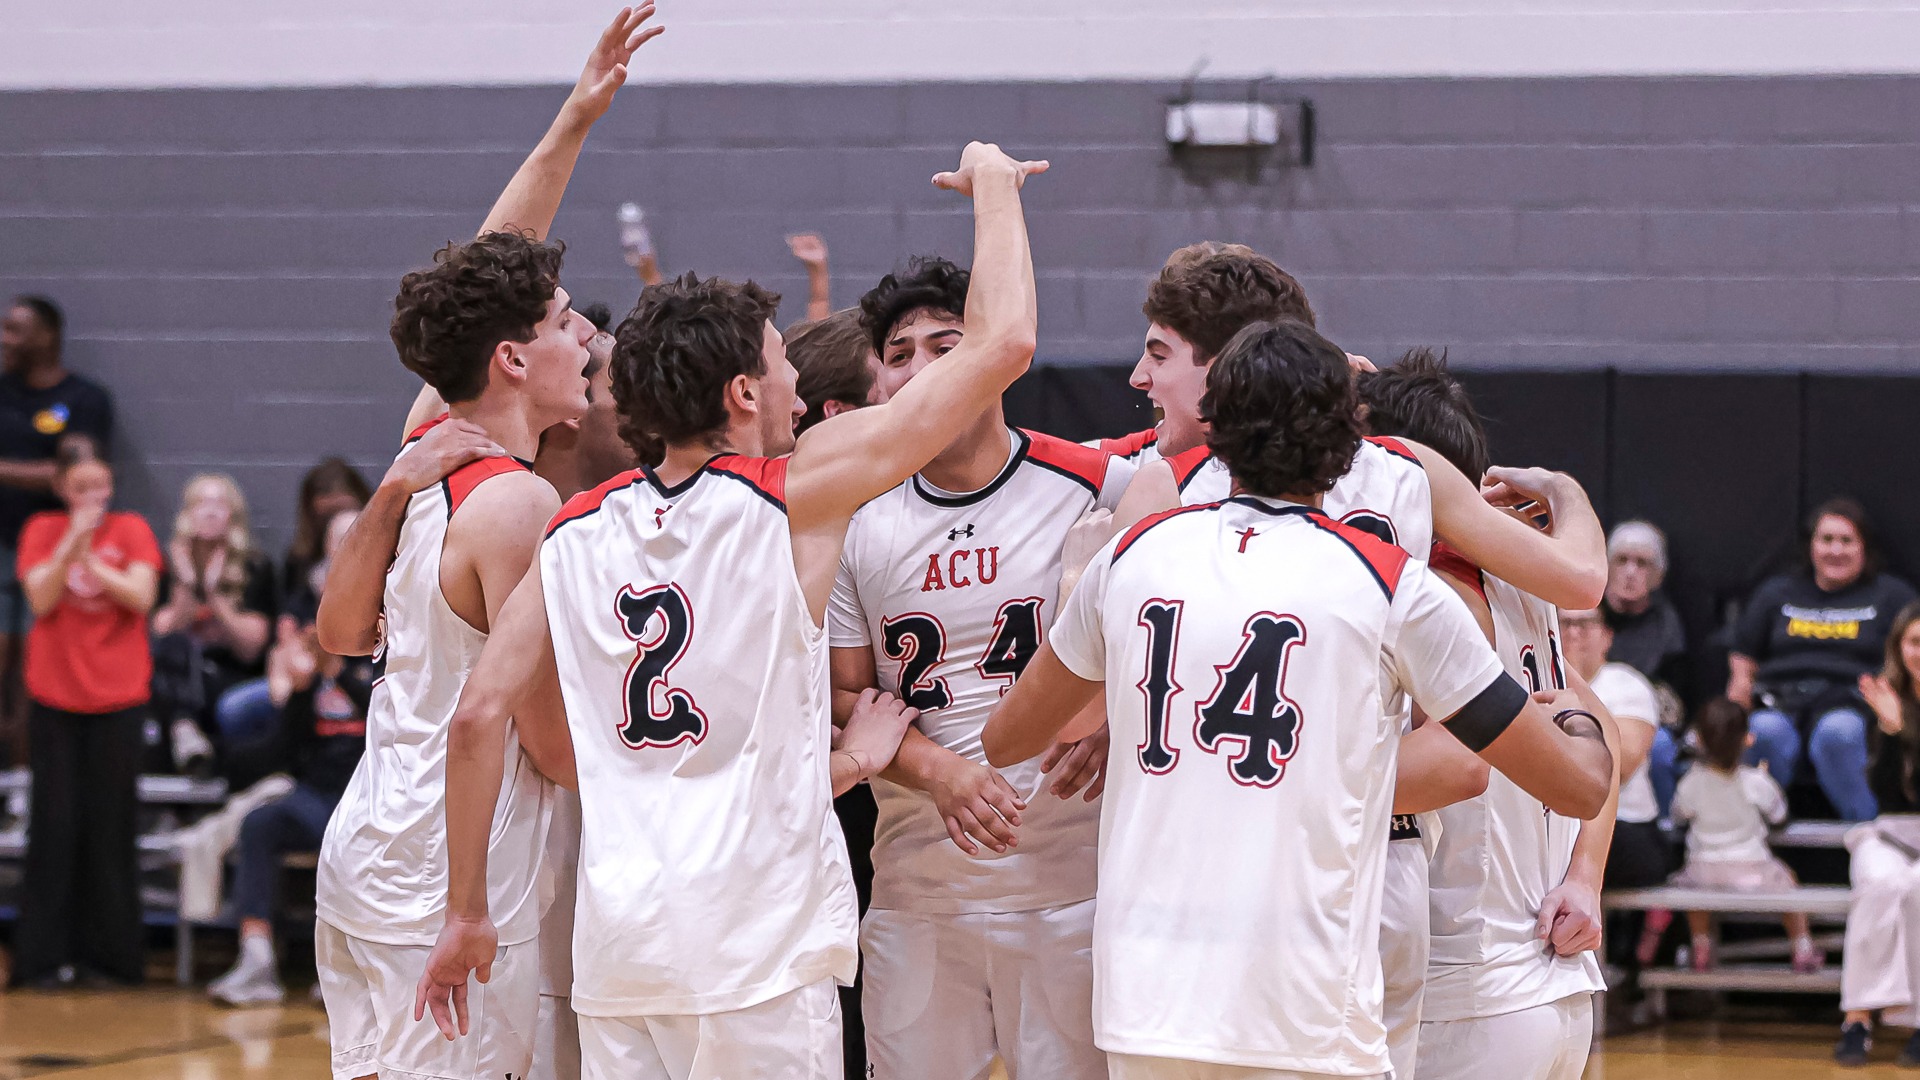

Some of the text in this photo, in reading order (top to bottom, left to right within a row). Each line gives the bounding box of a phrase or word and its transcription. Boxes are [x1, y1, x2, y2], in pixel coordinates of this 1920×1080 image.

[921, 547, 999, 591] ACU
[615, 582, 709, 749] 2
[1137, 598, 1307, 788] 14
